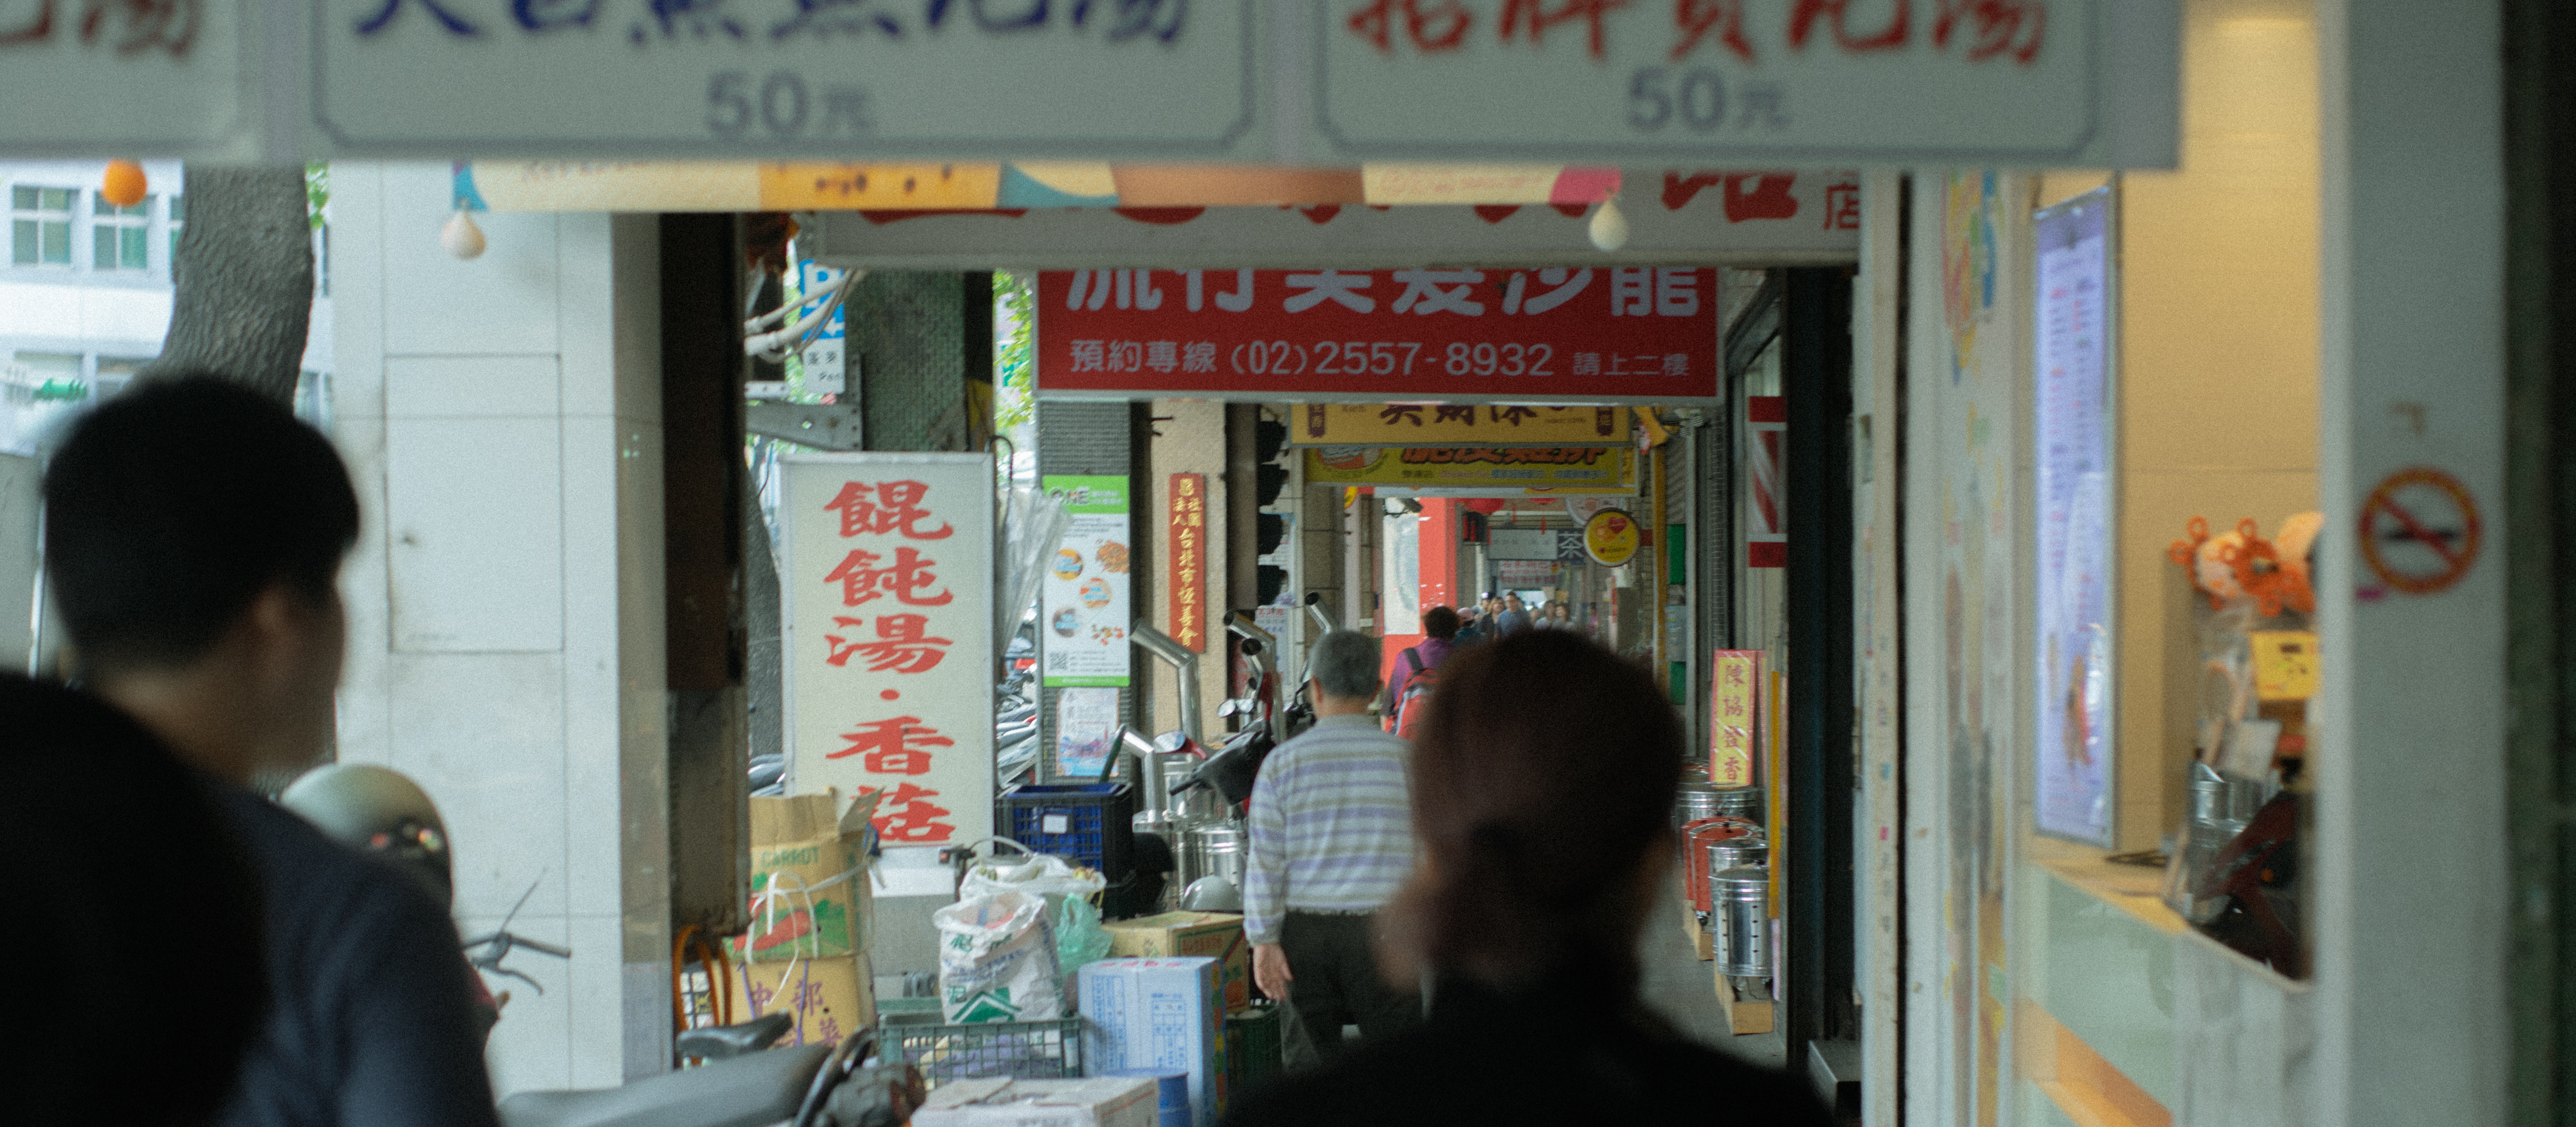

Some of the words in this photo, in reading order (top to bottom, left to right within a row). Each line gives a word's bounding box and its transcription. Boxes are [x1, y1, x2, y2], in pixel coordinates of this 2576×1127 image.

[706, 69, 877, 137] 50元
[1625, 65, 1793, 133] 50元
[1231, 341, 1553, 376] (02)2557-8932
[1559, 532, 1584, 559] 茶
[761, 846, 820, 868] CARROT
